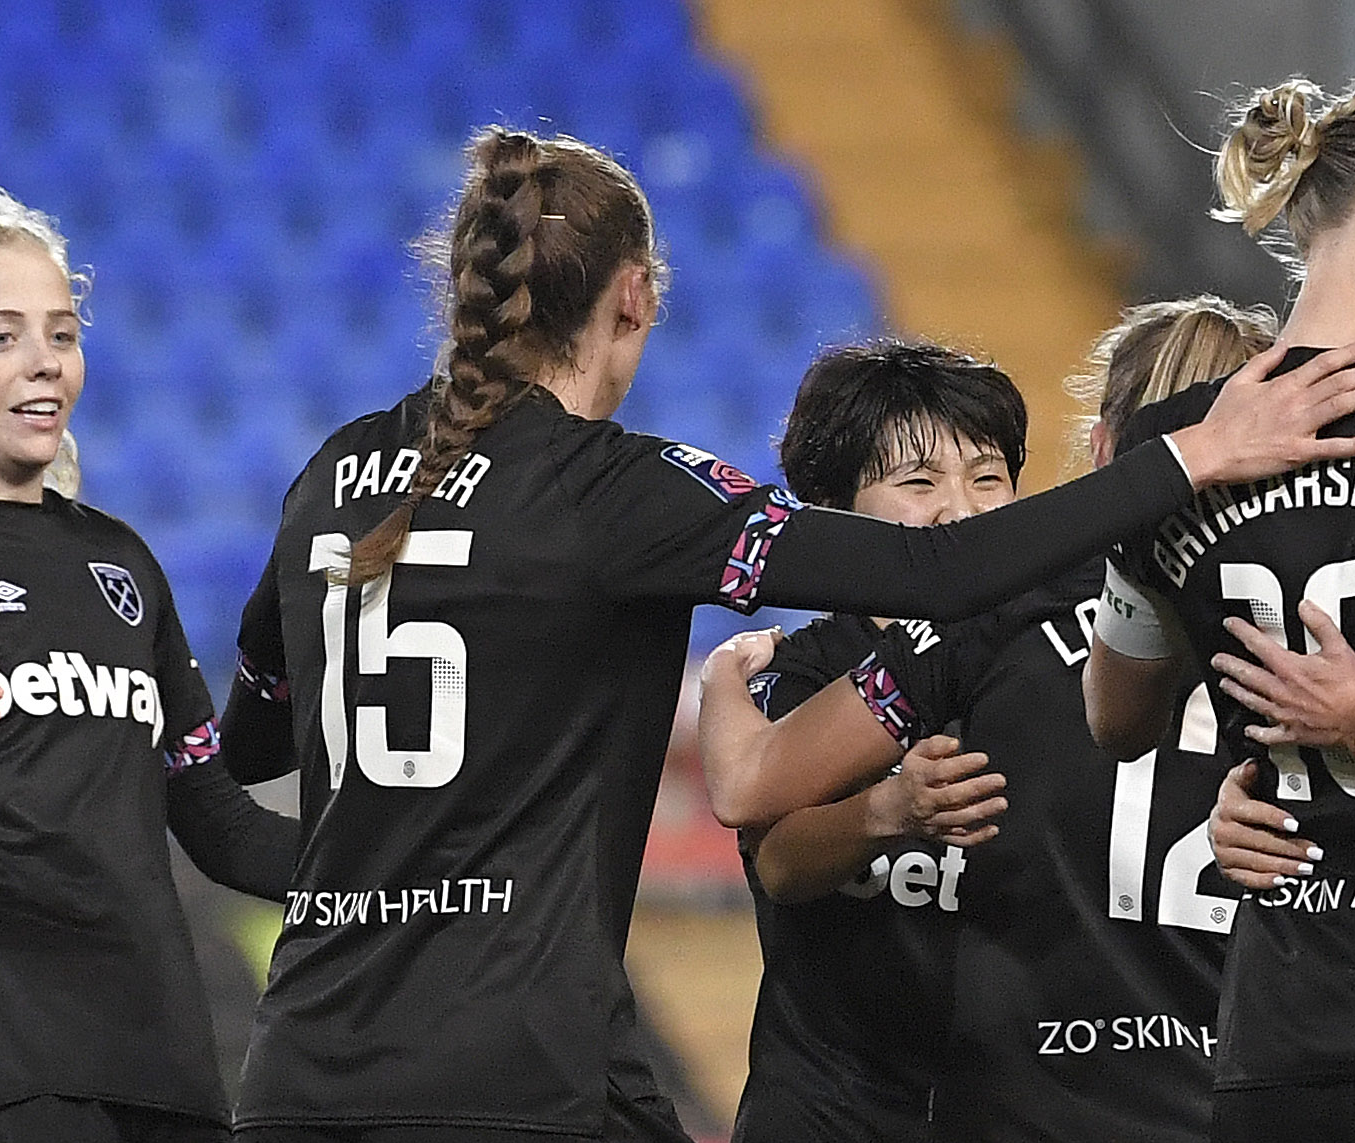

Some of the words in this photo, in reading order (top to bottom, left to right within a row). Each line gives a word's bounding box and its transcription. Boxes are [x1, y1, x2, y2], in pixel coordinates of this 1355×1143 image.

[335, 448, 491, 508] PARER
[308, 530, 474, 788] 15
[1109, 681, 1239, 935] 12
